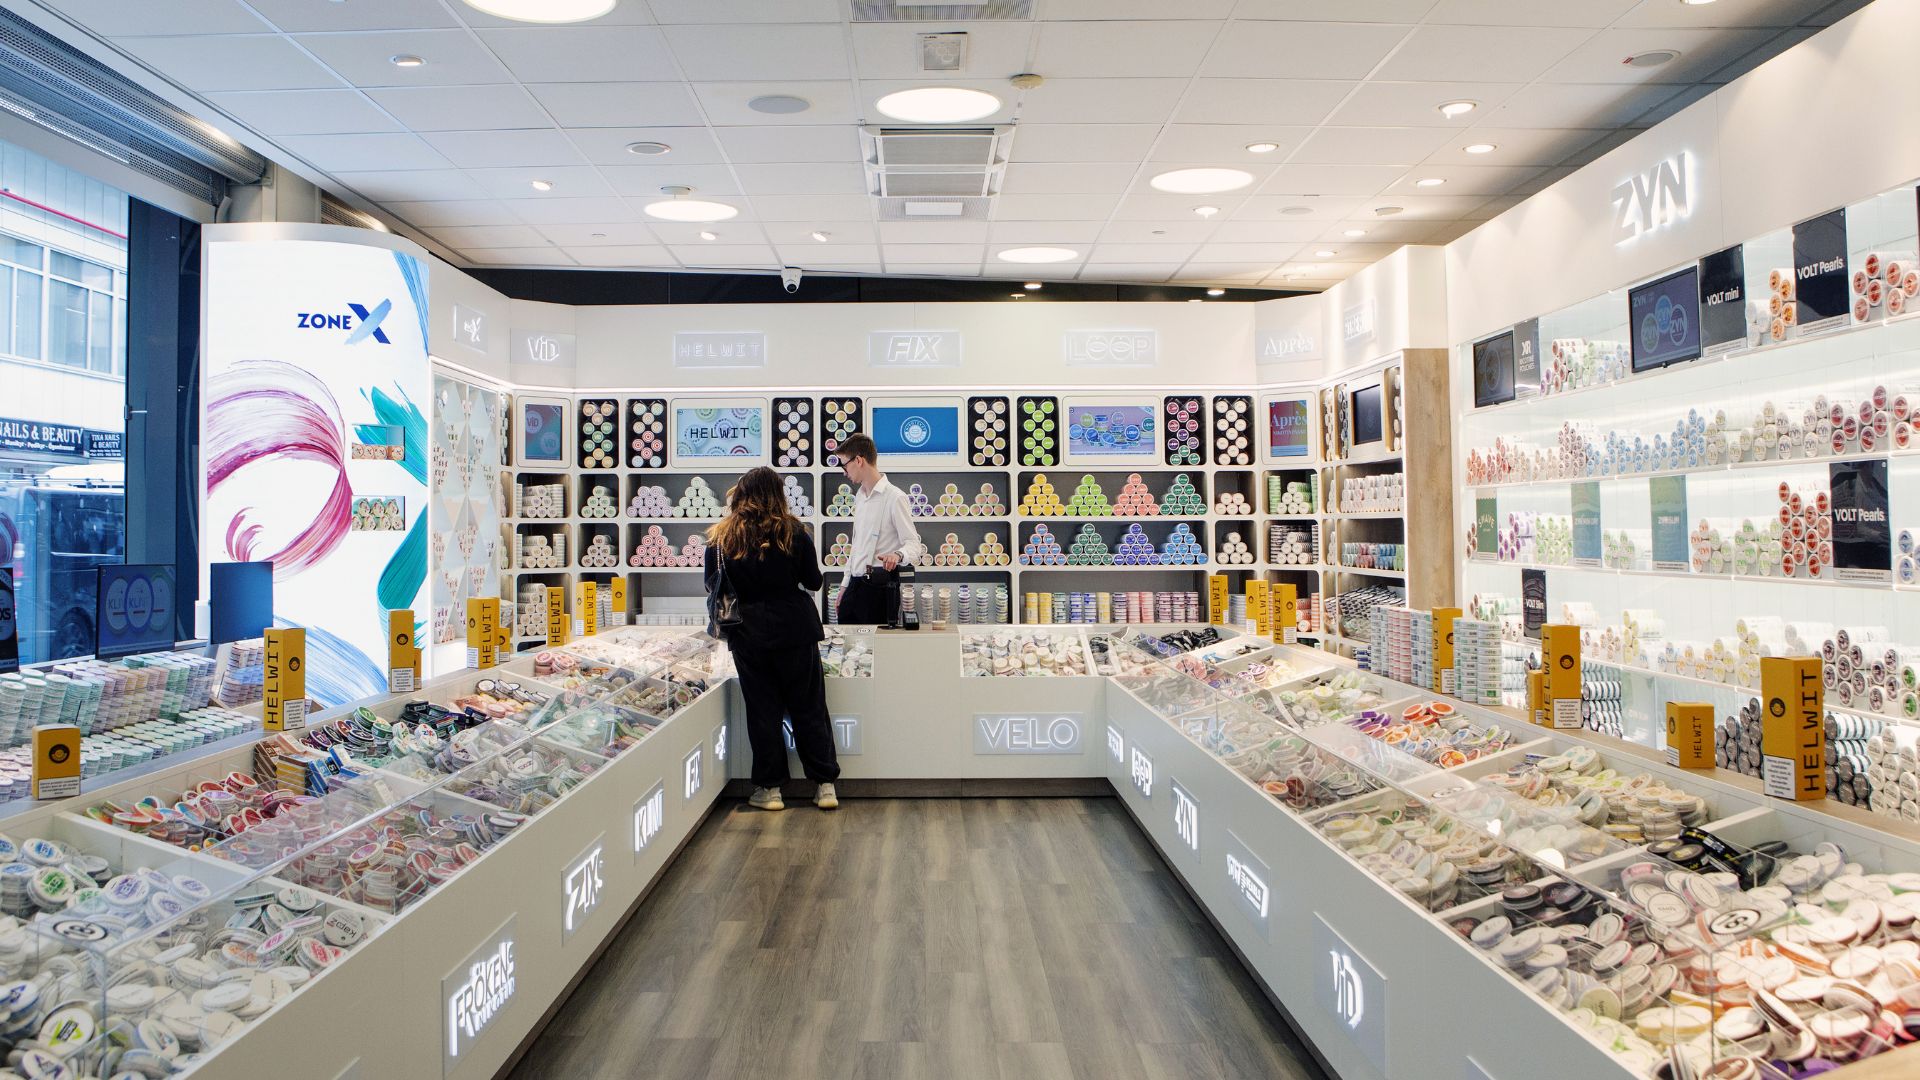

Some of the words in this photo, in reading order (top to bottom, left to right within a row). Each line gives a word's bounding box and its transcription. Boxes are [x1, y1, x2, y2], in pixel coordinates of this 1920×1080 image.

[1611, 152, 1688, 246] ZYN
[1797, 263, 1818, 280] VOLT
[1819, 257, 1844, 274] Pearls
[1707, 291, 1724, 306] VOLT
[1725, 286, 1739, 301] mini
[297, 313, 352, 330] ZONE
[1670, 318, 1684, 332] ZYN
[678, 343, 761, 358] HELWIT
[888, 335, 942, 361] FIX
[1070, 335, 1150, 361] LOOP
[1264, 332, 1313, 357] Après
[1521, 340, 1531, 356] XR
[1271, 410, 1307, 429] Après
[31, 425, 40, 440] &
[42, 426, 84, 444] BEAUTY
[690, 427, 749, 439] HELWIT
[1834, 508, 1857, 522] VOLT
[1858, 507, 1885, 522] Pearls
[1213, 578, 1221, 622] HELWIT
[1259, 584, 1267, 633] HELWIT
[1525, 598, 1536, 608] VOLT
[551, 591, 561, 643] HELWIT
[1273, 588, 1281, 640] HELWIT
[482, 603, 492, 664] HELWIT
[267, 635, 279, 724] HELWIT
[1543, 633, 1551, 722] HELWIT
[980, 717, 1080, 750] VELO
[1693, 715, 1702, 759] HELWIT
[1801, 668, 1820, 792] HELWIT
[685, 750, 701, 798] FIX
[1173, 787, 1198, 850] ZYN
[330, 916, 357, 938] kapz
